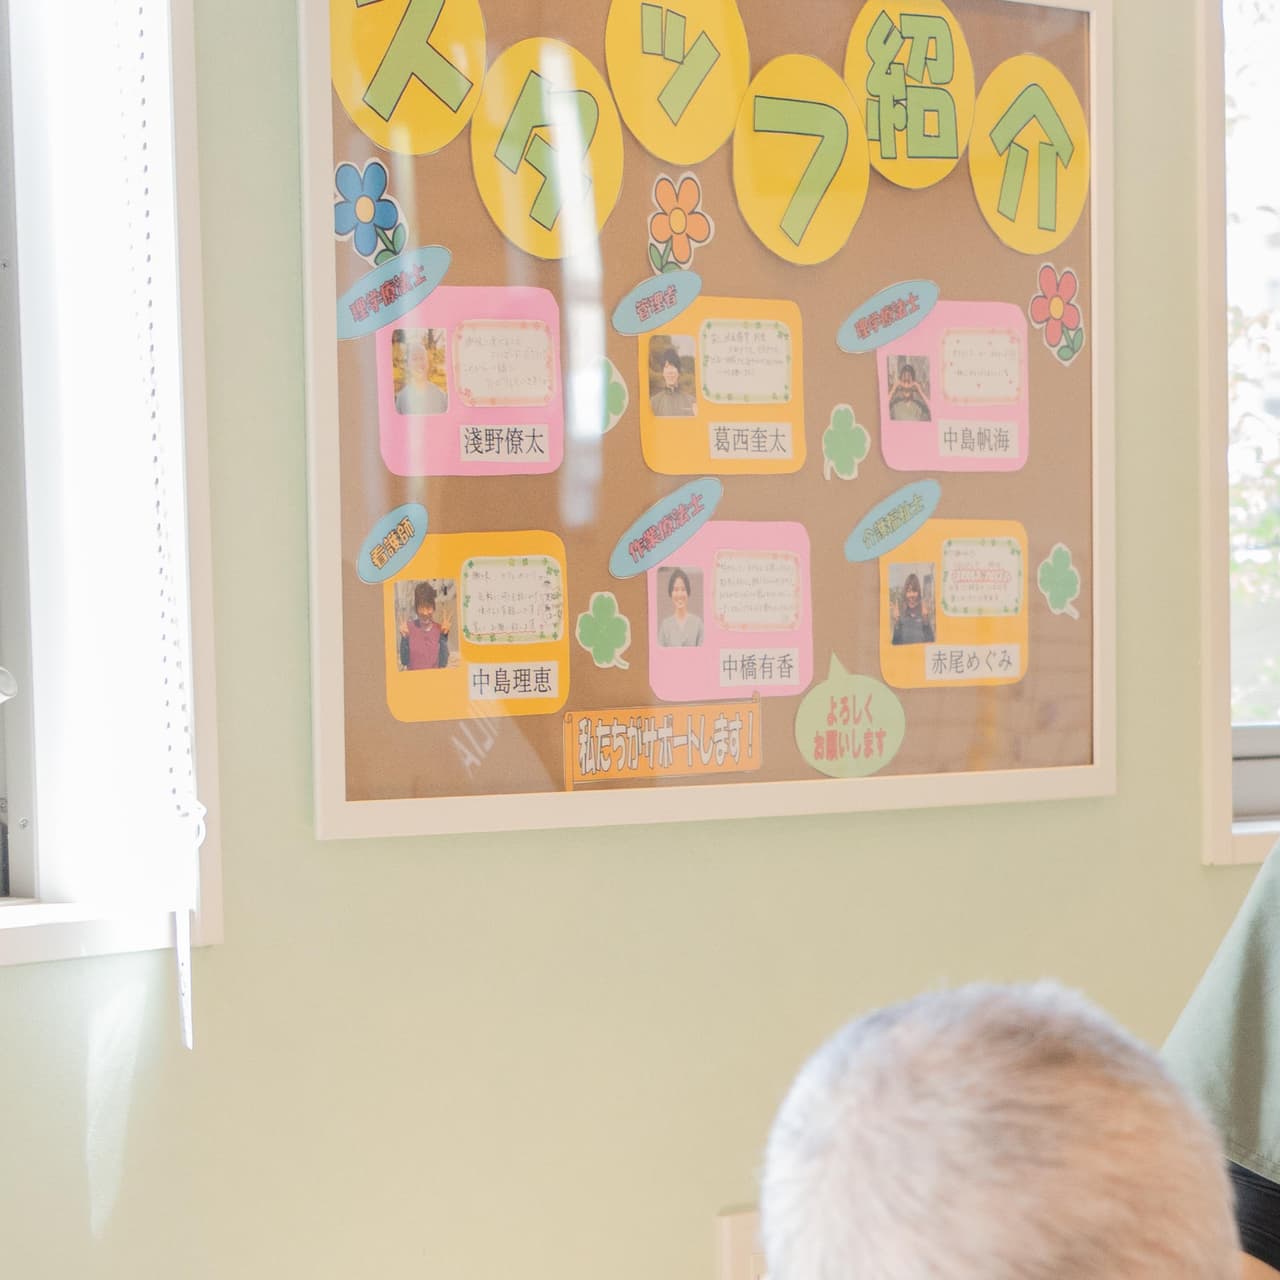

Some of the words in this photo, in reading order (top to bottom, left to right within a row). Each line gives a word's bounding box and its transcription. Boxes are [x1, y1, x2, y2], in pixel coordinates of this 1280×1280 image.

[635, 285, 677, 322] 管理者
[369, 516, 416, 569] 看護師
[628, 493, 705, 563] 作業療法士
[722, 654, 794, 681] 中橋有香
[931, 650, 1013, 675] 赤尾めぐみ
[472, 667, 552, 696] 中島理恵
[826, 694, 873, 724] よろしく
[813, 728, 887, 762] お願いします
